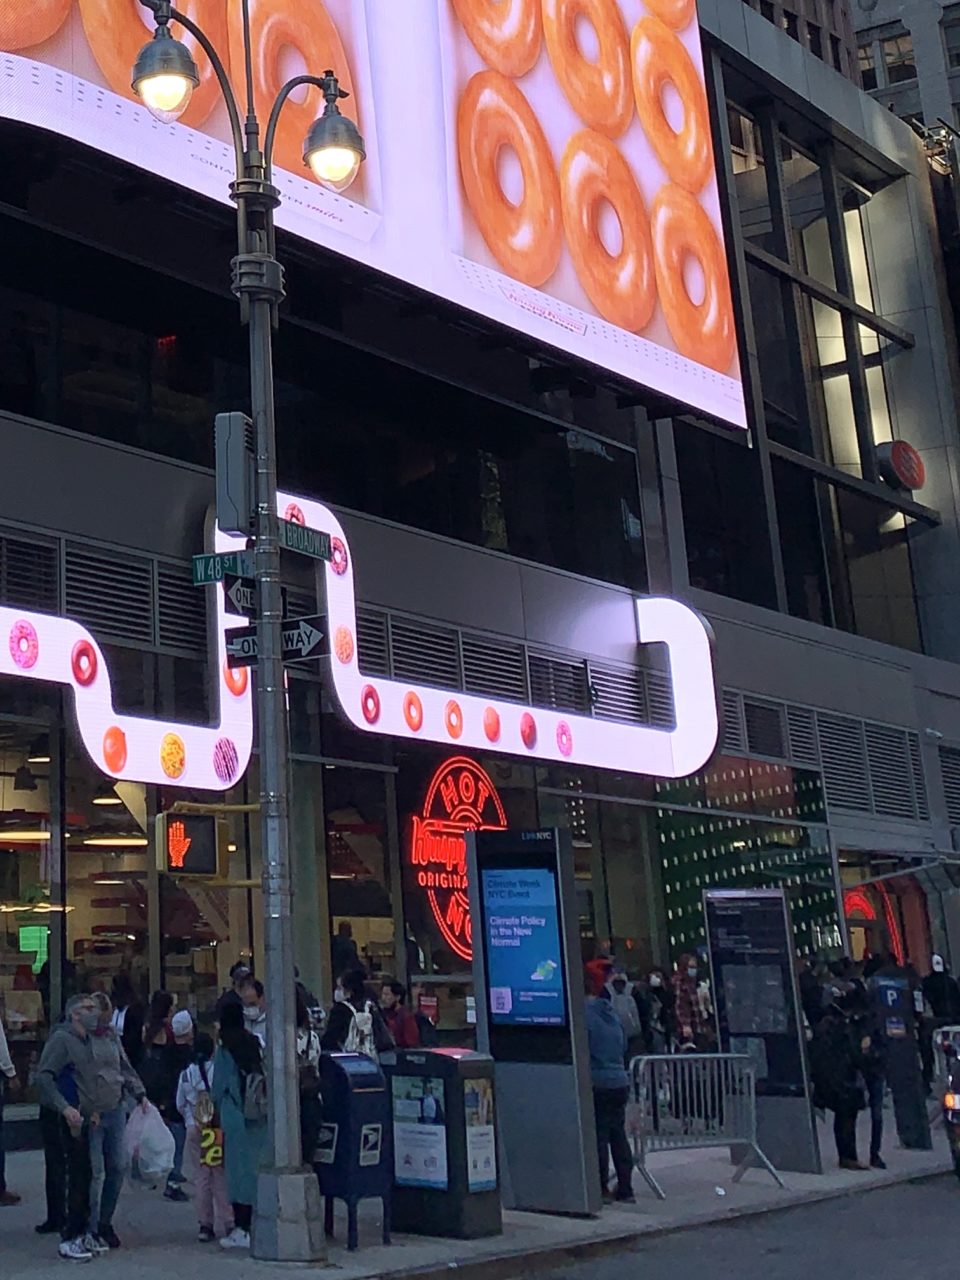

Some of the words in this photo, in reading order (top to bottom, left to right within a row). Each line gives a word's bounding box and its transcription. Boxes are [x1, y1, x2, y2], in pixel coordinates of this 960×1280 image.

[288, 524, 329, 557] BROADWAY
[196, 560, 206, 580] W
[208, 558, 221, 580] 48
[224, 556, 234, 567] ST
[242, 637, 258, 654] ON
[284, 628, 314, 649] WAY
[440, 771, 491, 813] HOT
[418, 871, 469, 889] ORIGINA
[489, 916, 520, 925] Climate
[521, 915, 546, 927] Policy
[499, 927, 513, 935] the
[513, 927, 532, 936] New
[491, 937, 520, 946] Normal
